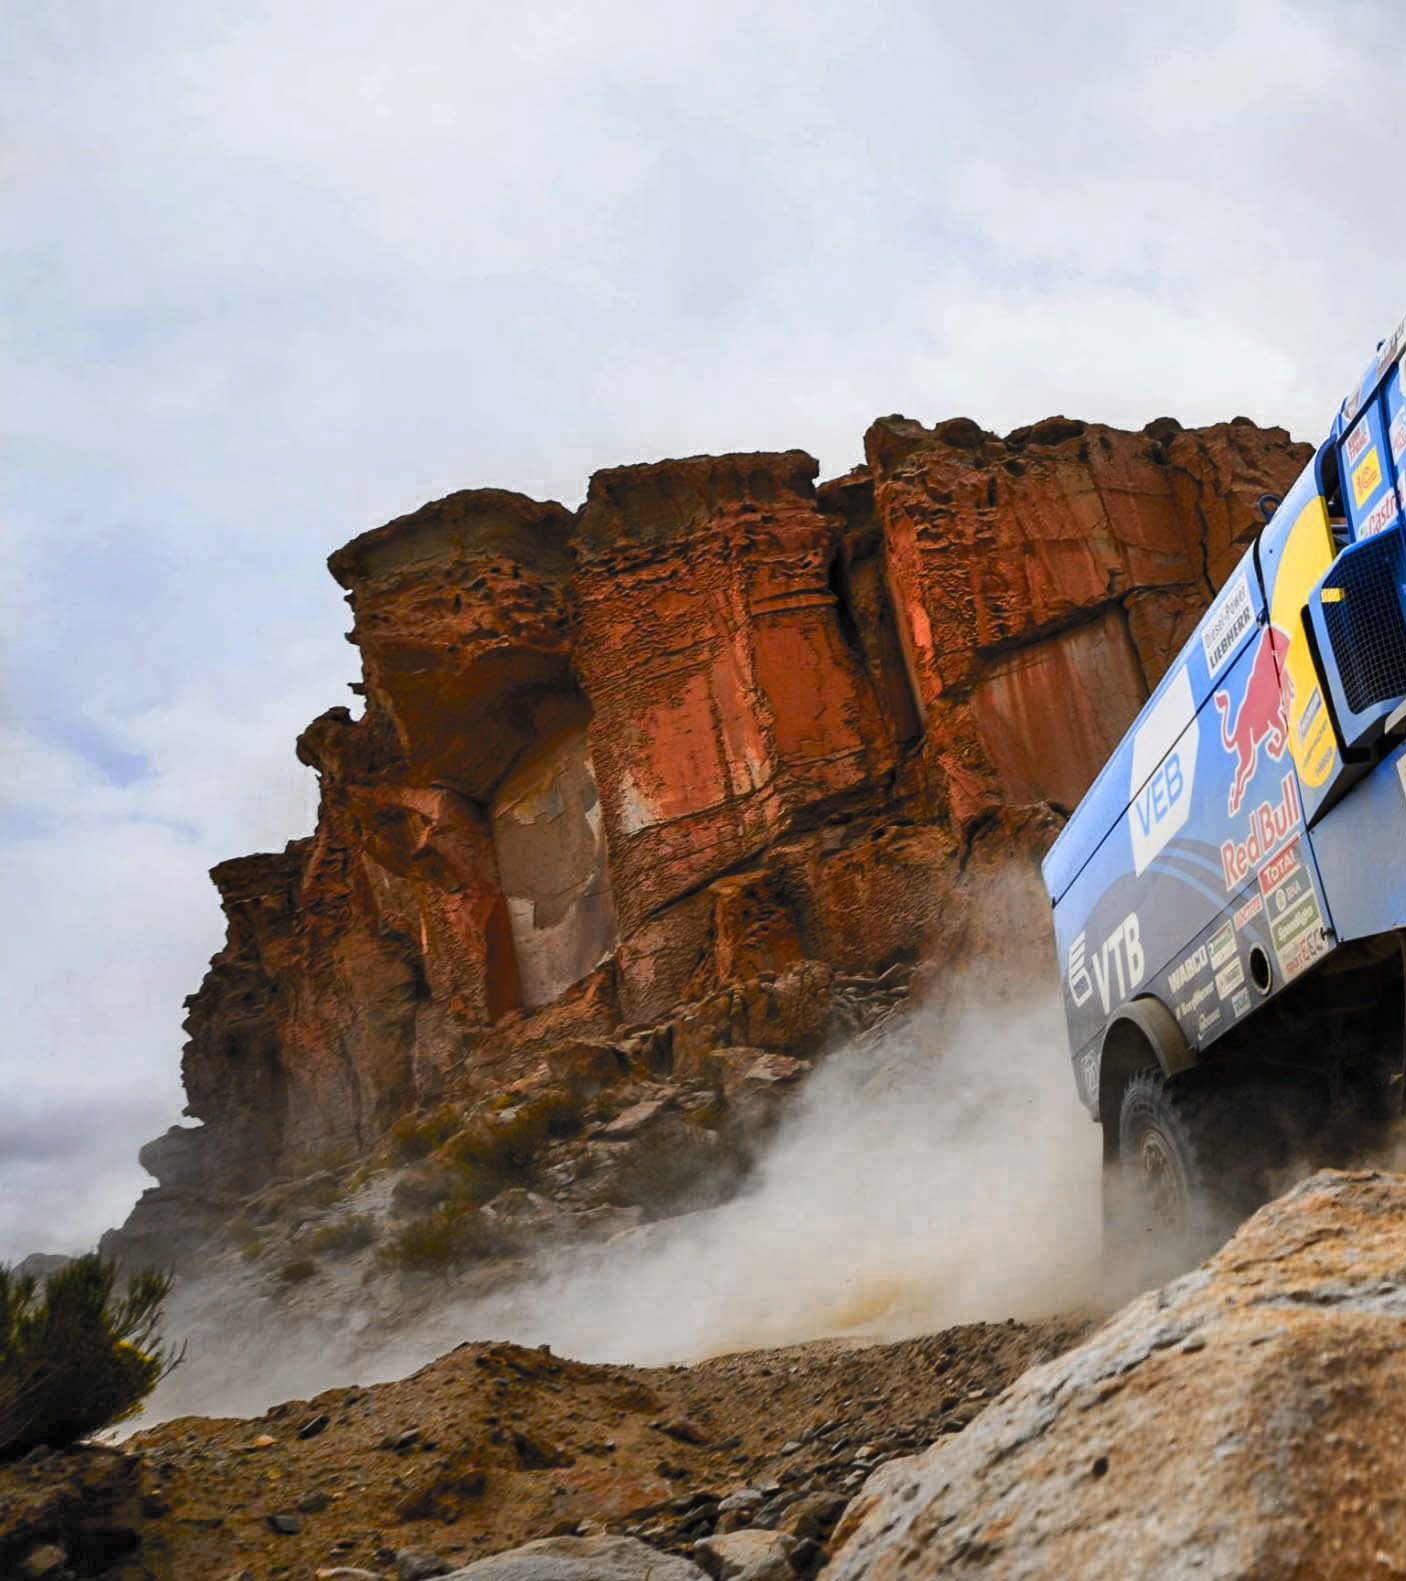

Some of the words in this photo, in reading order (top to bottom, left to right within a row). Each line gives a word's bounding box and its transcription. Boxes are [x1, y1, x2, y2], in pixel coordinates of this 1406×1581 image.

[1209, 606, 1251, 669] LIEBHERR
[1137, 753, 1184, 837] VEB
[1221, 808, 1261, 892] Red
[1258, 770, 1301, 856] Bull
[1264, 847, 1296, 884] TOTAL
[1092, 912, 1145, 1016] VTB
[1168, 945, 1208, 993] WABCO
